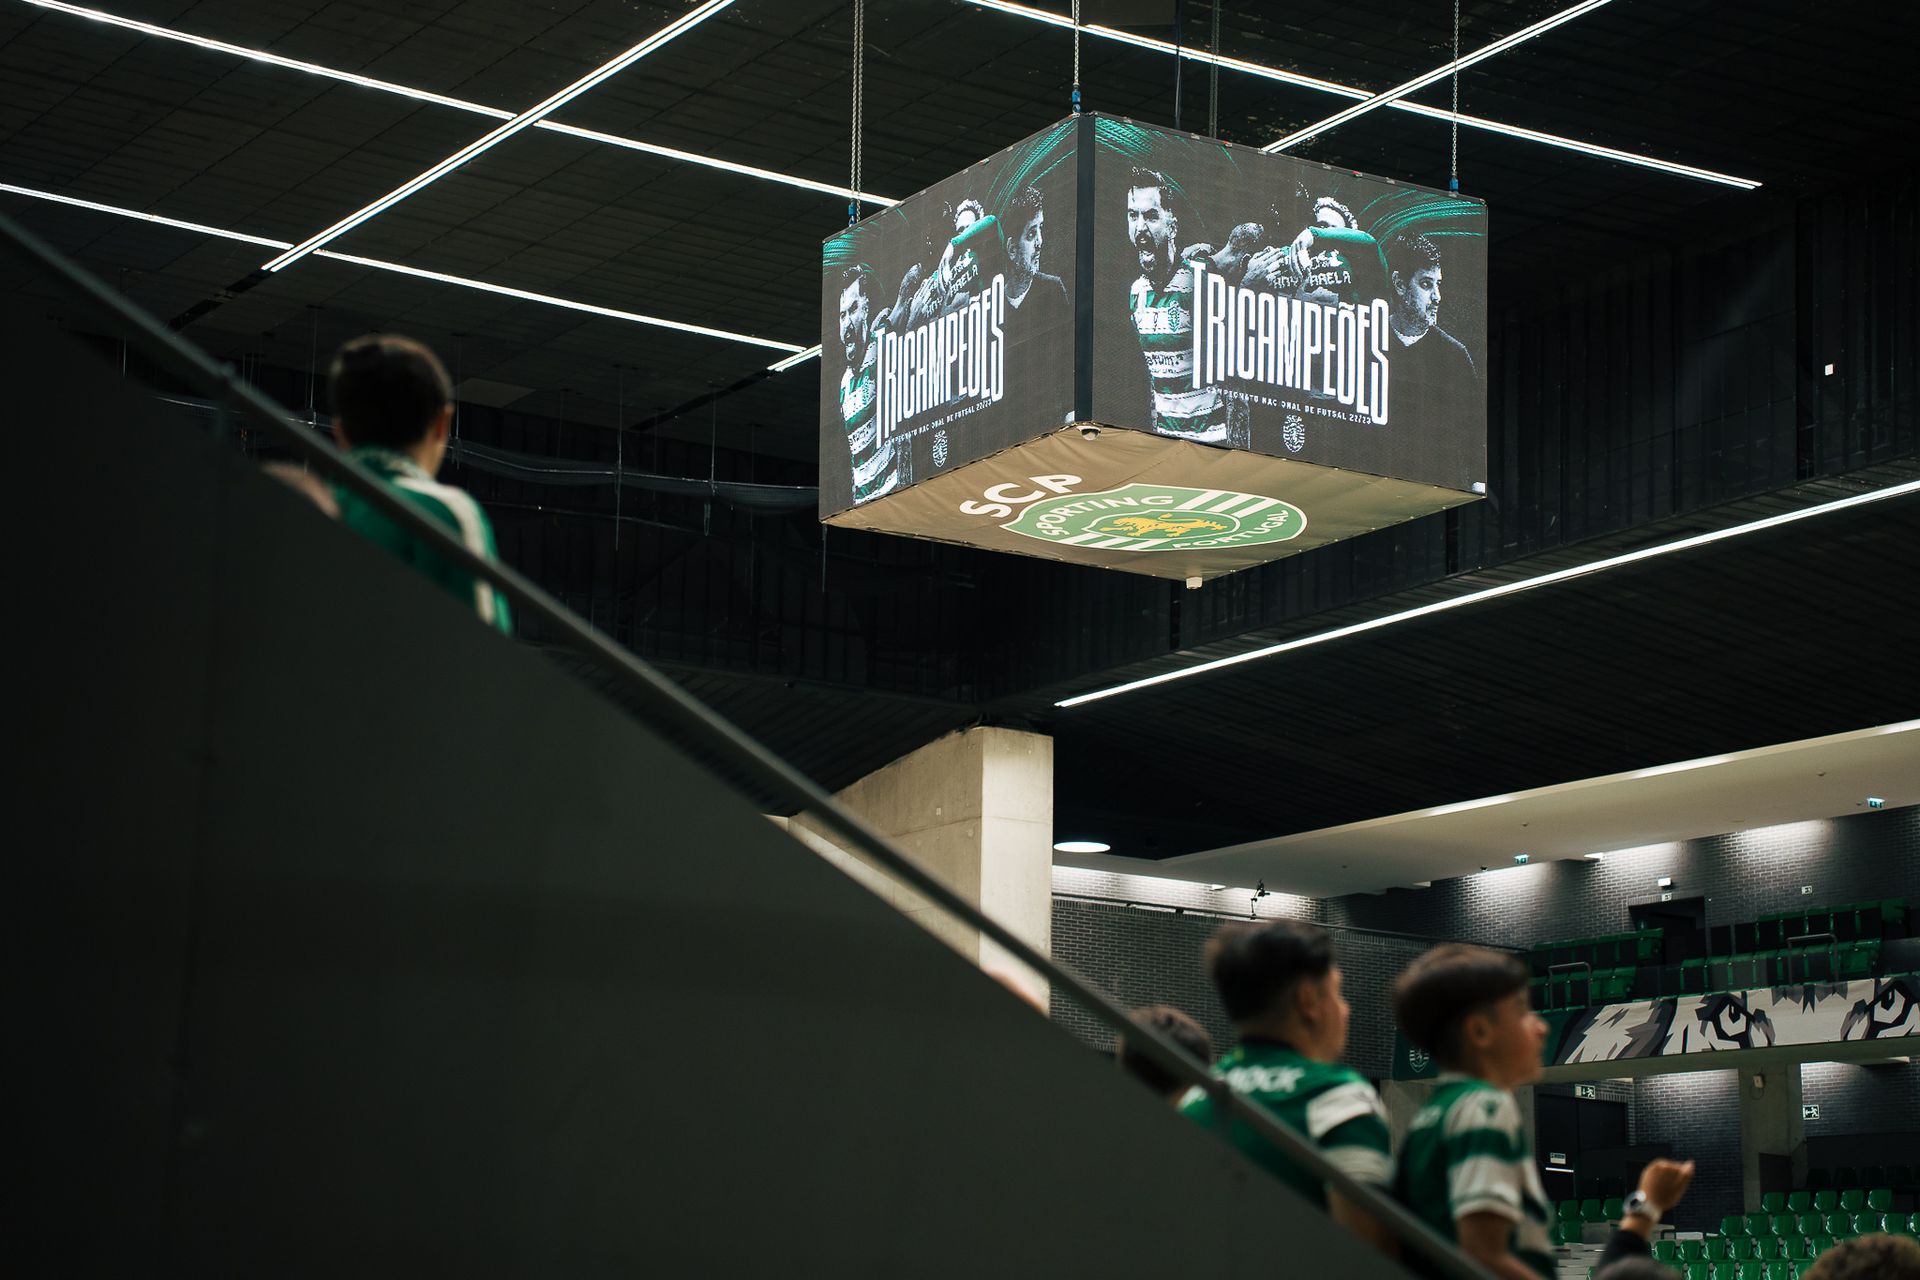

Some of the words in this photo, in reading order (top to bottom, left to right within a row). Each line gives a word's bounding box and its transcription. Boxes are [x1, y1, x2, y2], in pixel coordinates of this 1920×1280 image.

[875, 273, 1005, 449] TRICAMPEÕES
[1190, 260, 1390, 426] TRICAMPEÕES
[1262, 397, 1302, 412] NACONAL
[1304, 405, 1315, 415] DE
[1317, 408, 1347, 421] FUTSAL
[1349, 413, 1372, 425] 22/23
[959, 474, 1083, 518] SCP
[1036, 495, 1174, 536] SPORTING
